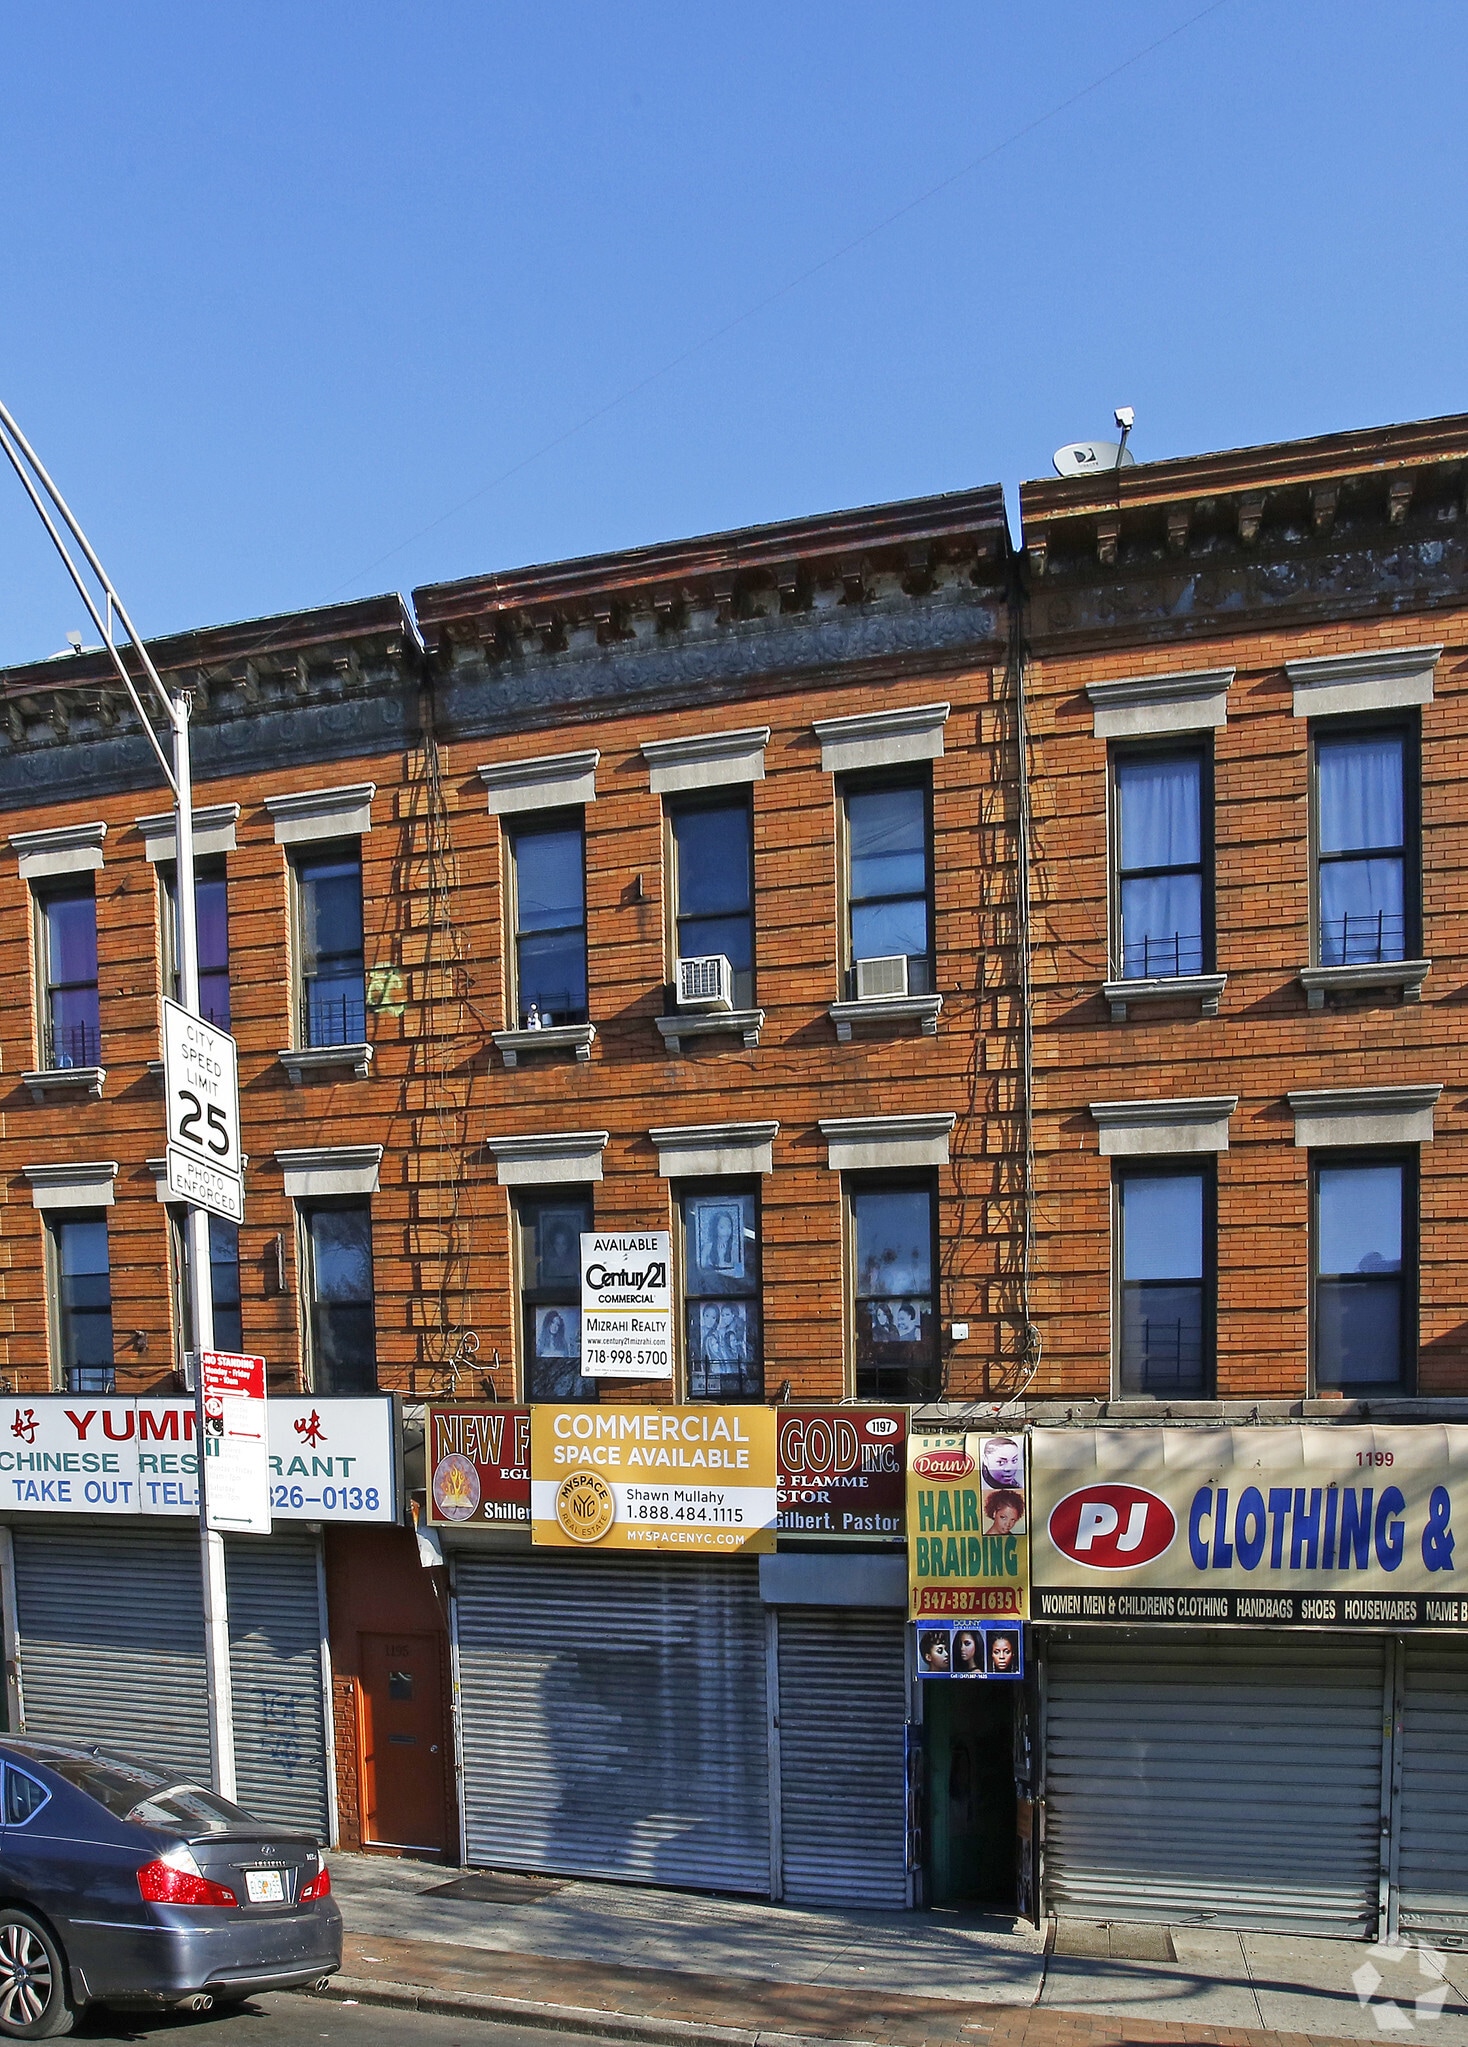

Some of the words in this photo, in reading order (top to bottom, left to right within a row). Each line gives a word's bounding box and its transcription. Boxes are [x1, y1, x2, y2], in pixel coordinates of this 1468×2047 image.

[186, 1025, 213, 1051] CITY
[181, 1043, 222, 1077] SPEED
[186, 1067, 218, 1096] LIMIT
[178, 1090, 230, 1156] 25
[187, 1163, 223, 1190] PHOTO
[176, 1174, 235, 1210] ENFORCED
[593, 1238, 658, 1251] AVAILABLE
[597, 1294, 654, 1303] COMMERCIAL
[631, 1318, 667, 1332] REALTY
[587, 1337, 666, 1346] www.century21mizrahi.com
[204, 1354, 216, 1365] NO
[217, 1356, 254, 1370] STANDING
[587, 1349, 668, 1365] 718-998-5700
[205, 1365, 228, 1377] Monday
[232, 1368, 250, 1380] Friday
[10, 1408, 40, 1444] 好
[293, 1408, 328, 1449] 味
[553, 1413, 749, 1442] COMMERCIAL
[871, 1421, 891, 1433] 1197
[434, 1414, 505, 1465] NEW
[780, 1418, 858, 1472] GOD
[861, 1443, 900, 1473] INC.
[0, 1451, 120, 1473] CHINESE
[553, 1445, 621, 1466] SPACE
[627, 1446, 749, 1469] AVAILABLE
[918, 1457, 971, 1475] Douny
[1355, 1451, 1394, 1467] 1199
[12, 1479, 72, 1502] TAKE
[84, 1480, 133, 1503] OUT
[146, 1481, 200, 1505] TEL:
[561, 1475, 608, 1500] MYSPACE
[790, 1475, 869, 1488] FLAMME
[573, 1494, 596, 1518] NYC
[626, 1488, 669, 1502] Shawn
[674, 1490, 725, 1506] Mullahy
[627, 1504, 743, 1522] 1.888.484.1115
[842, 1512, 900, 1531] Pastor
[918, 1490, 979, 1531] HAIR
[561, 1513, 579, 1535] REAL
[582, 1514, 607, 1536] ESTATE
[1074, 1502, 1149, 1551] PJ
[1188, 1486, 1406, 1572] CLOTHING
[1421, 1485, 1456, 1572] &
[627, 1530, 745, 1545] MYSPACENYC.COM
[916, 1536, 1019, 1577] BRAIDING
[923, 1592, 1013, 1610] 347-387-1635
[1041, 1594, 1080, 1614] WOMEN
[1083, 1595, 1106, 1615] MEN
[1108, 1596, 1116, 1615] &
[1118, 1596, 1175, 1616] CHILDREN'S
[1177, 1597, 1229, 1617] CLOTHING
[1236, 1598, 1293, 1619] HANDBAGS
[1301, 1599, 1337, 1620] SHOES
[1344, 1600, 1417, 1620] HOUSEWARES
[1426, 1601, 1458, 1621] NAME
